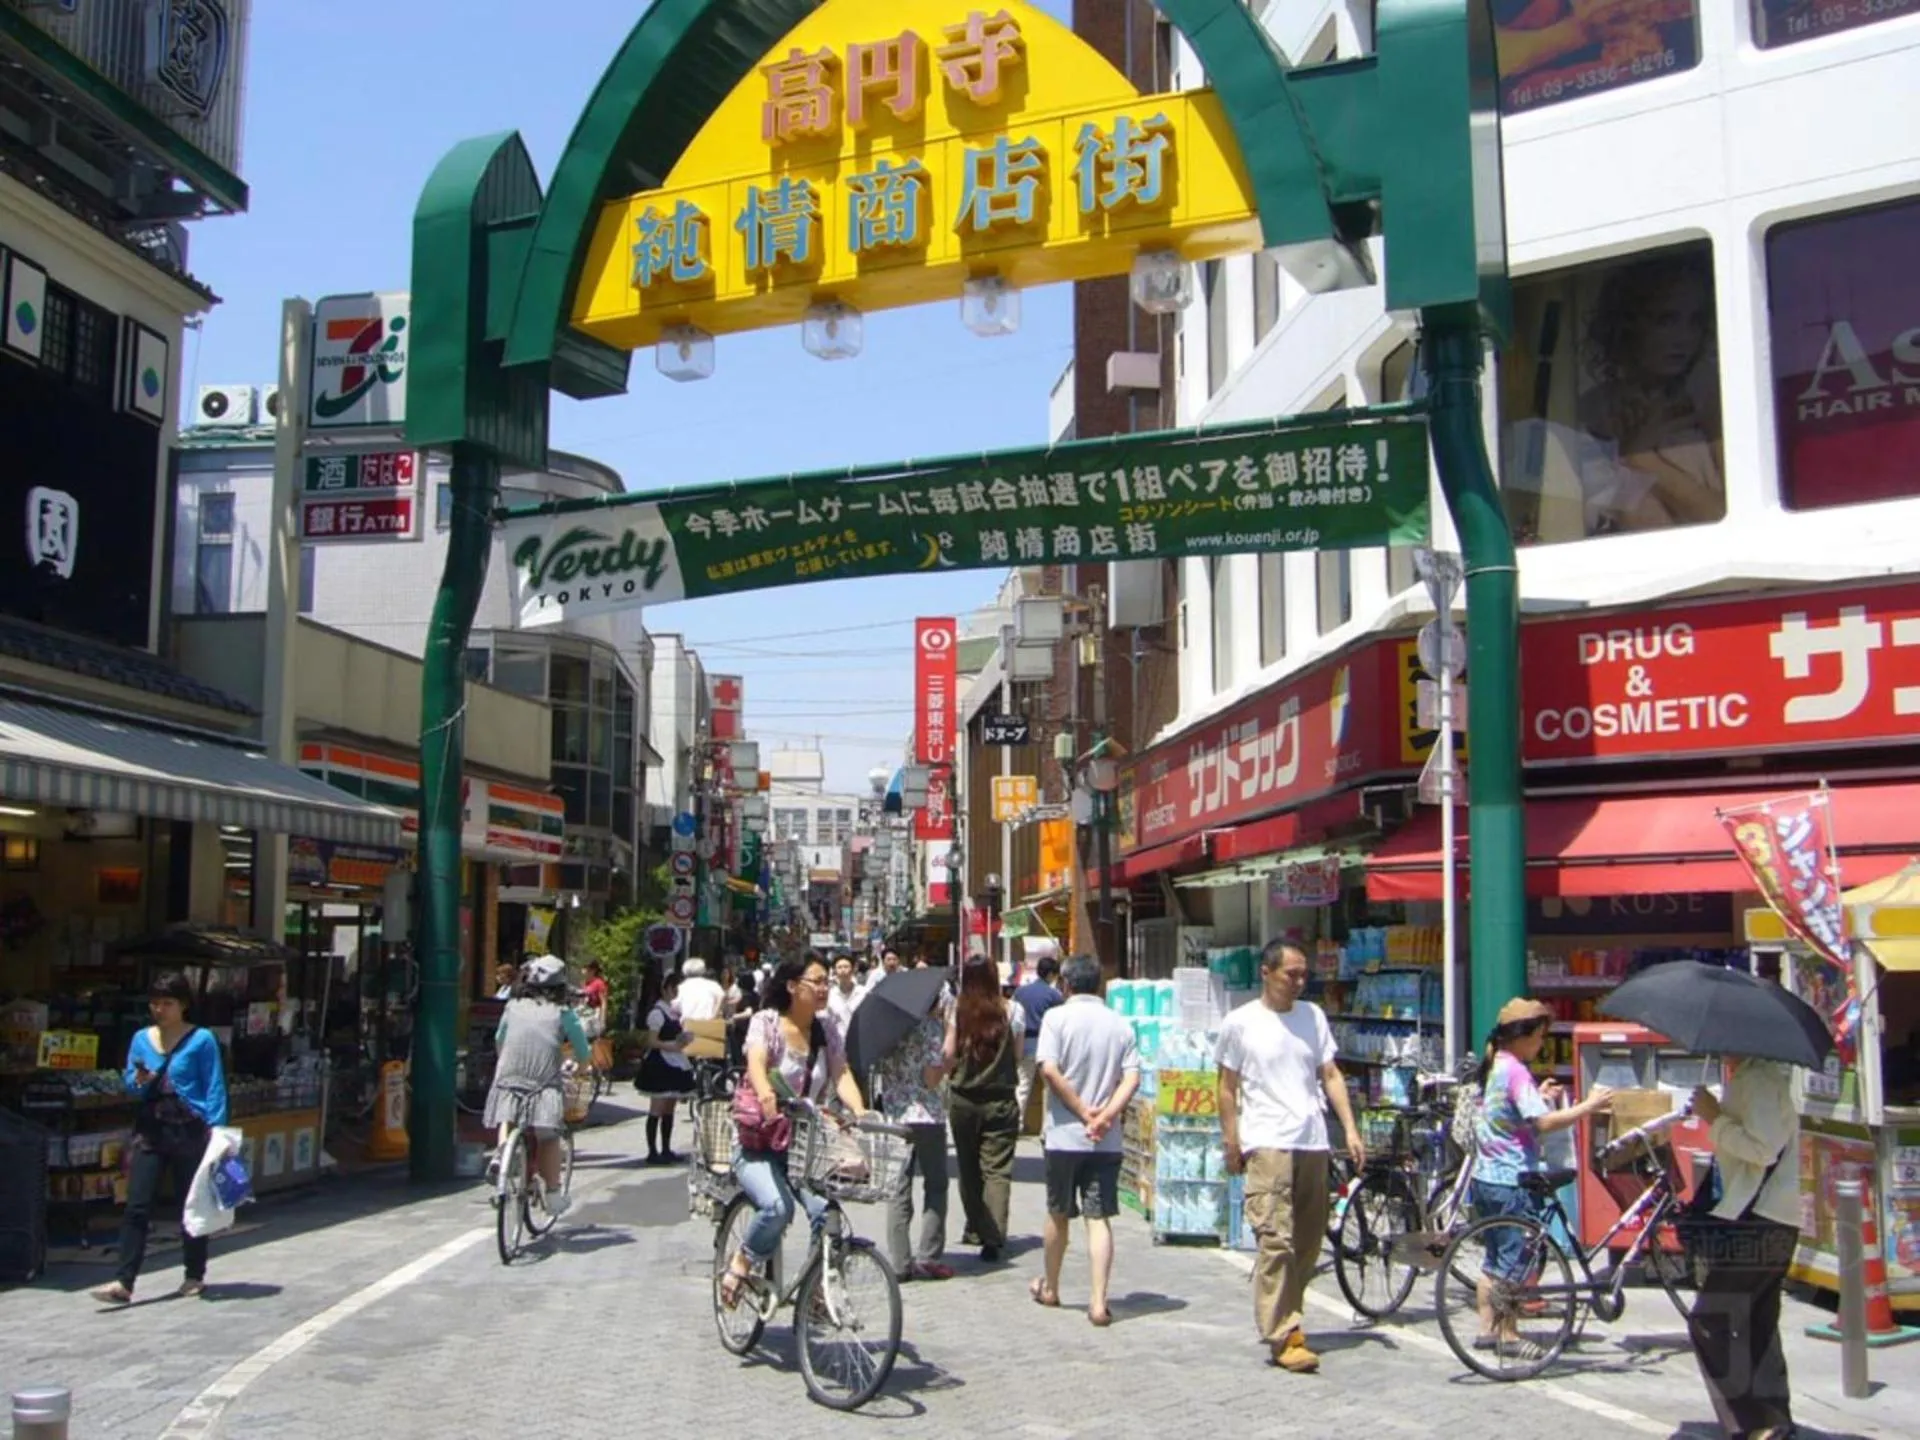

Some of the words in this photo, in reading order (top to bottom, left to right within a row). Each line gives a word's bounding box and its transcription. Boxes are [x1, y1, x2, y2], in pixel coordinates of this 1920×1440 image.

[761, 10, 1022, 140] 高円寺
[631, 113, 1173, 285] 純情商店街
[1798, 392, 1893, 420] HAIR
[317, 457, 346, 488] 酒
[363, 454, 411, 486] たばこ
[513, 526, 668, 590] Verdy
[979, 522, 1157, 560] 純情商店街
[1185, 527, 1320, 549] www.kouenji.or.jp
[538, 580, 636, 608] TOKYO
[1578, 622, 1696, 666] DRUG
[1769, 605, 1920, 725] サ
[1625, 664, 1653, 698] &
[1535, 692, 1750, 742] COSMETIC
[1187, 696, 1300, 818] サンドラッグ
